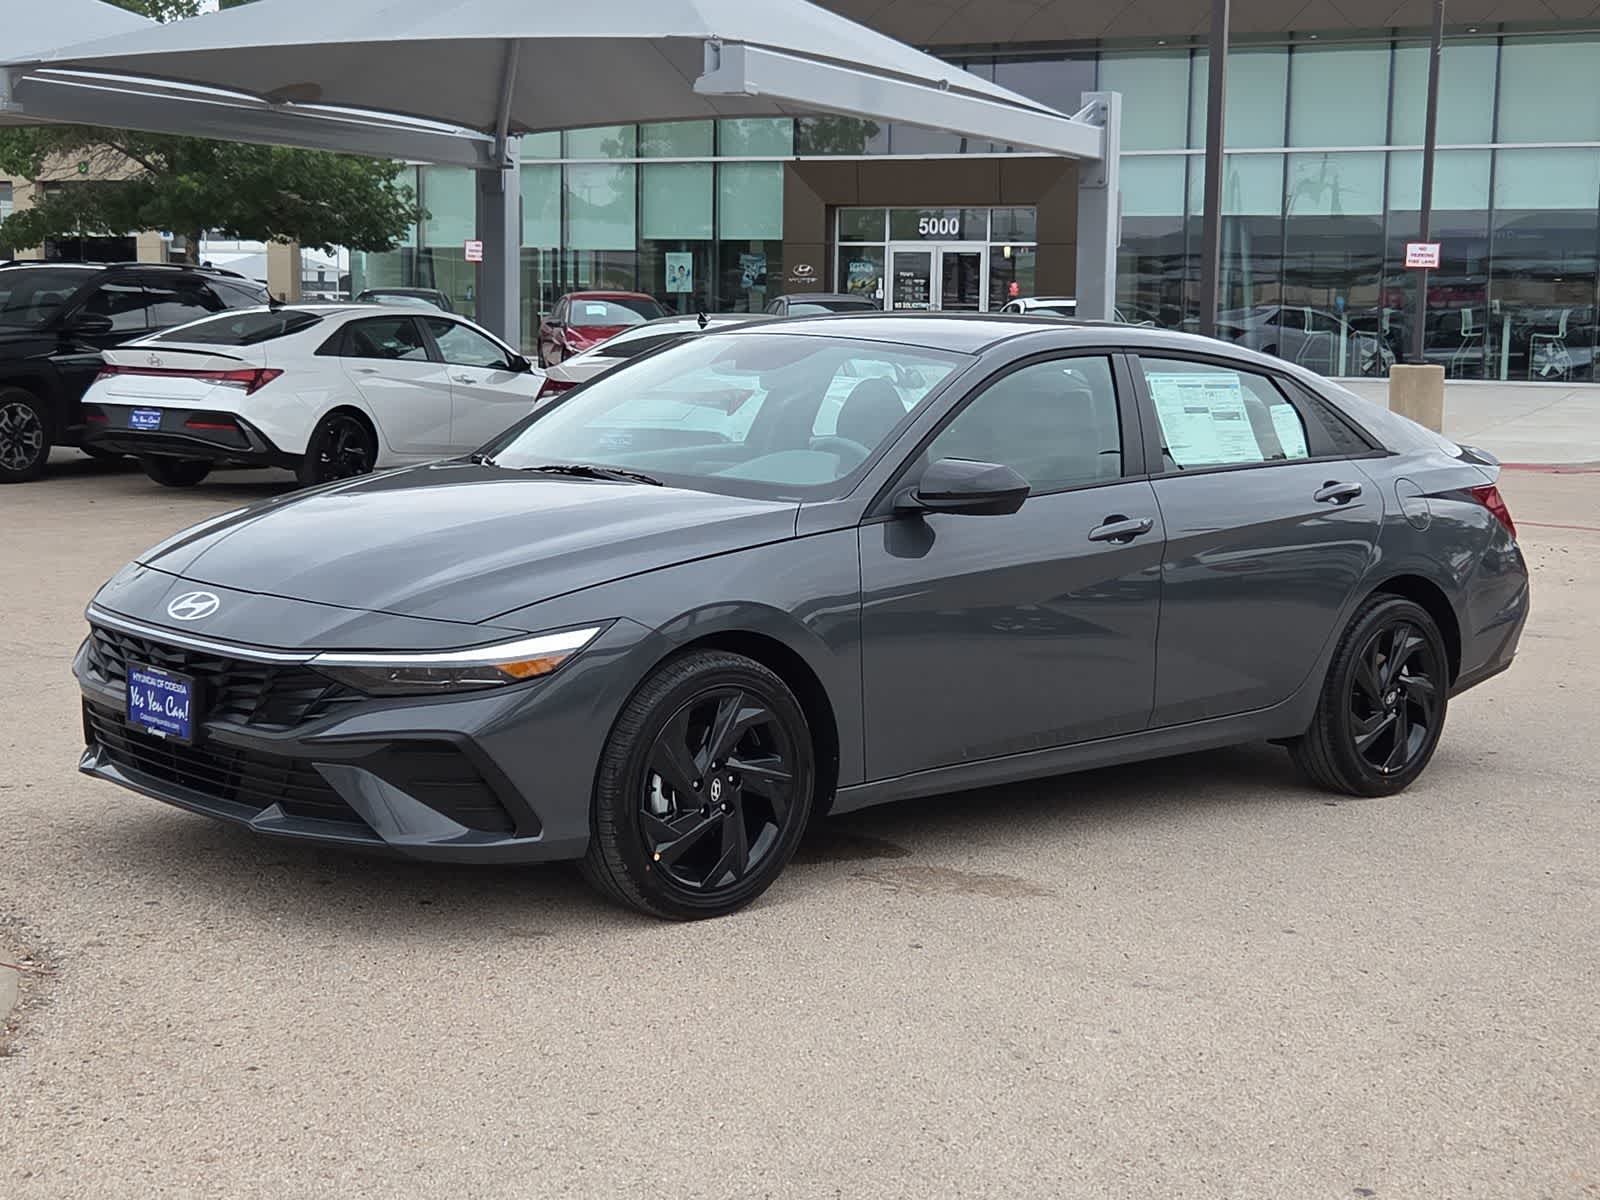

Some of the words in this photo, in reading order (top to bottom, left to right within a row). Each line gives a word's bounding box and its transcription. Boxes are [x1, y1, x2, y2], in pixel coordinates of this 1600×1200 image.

[918, 217, 960, 235] 5000
[130, 685, 145, 709] Yes
[166, 696, 190, 722] Can!
